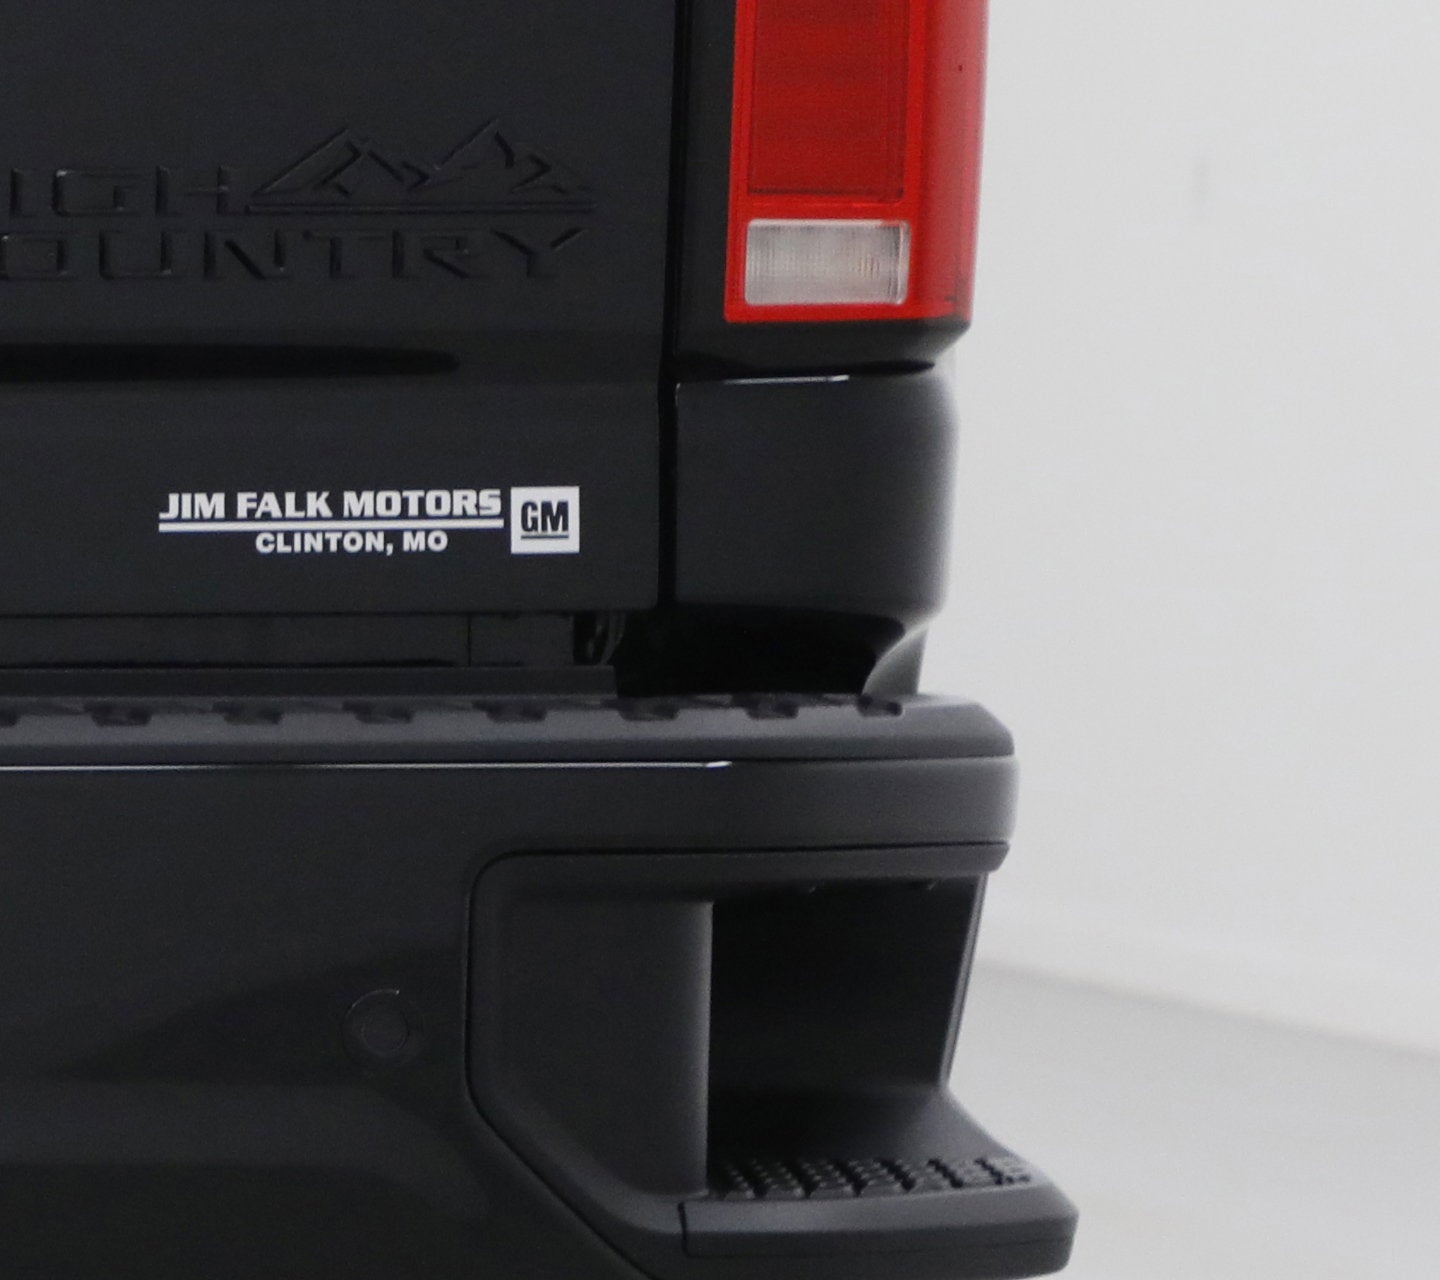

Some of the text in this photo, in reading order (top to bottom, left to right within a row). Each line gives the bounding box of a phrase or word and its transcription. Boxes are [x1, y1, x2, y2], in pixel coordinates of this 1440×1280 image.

[158, 488, 502, 521] JIM FALK MOTORS
[520, 500, 570, 533] GM
[254, 530, 449, 556] CLINTON, MO
